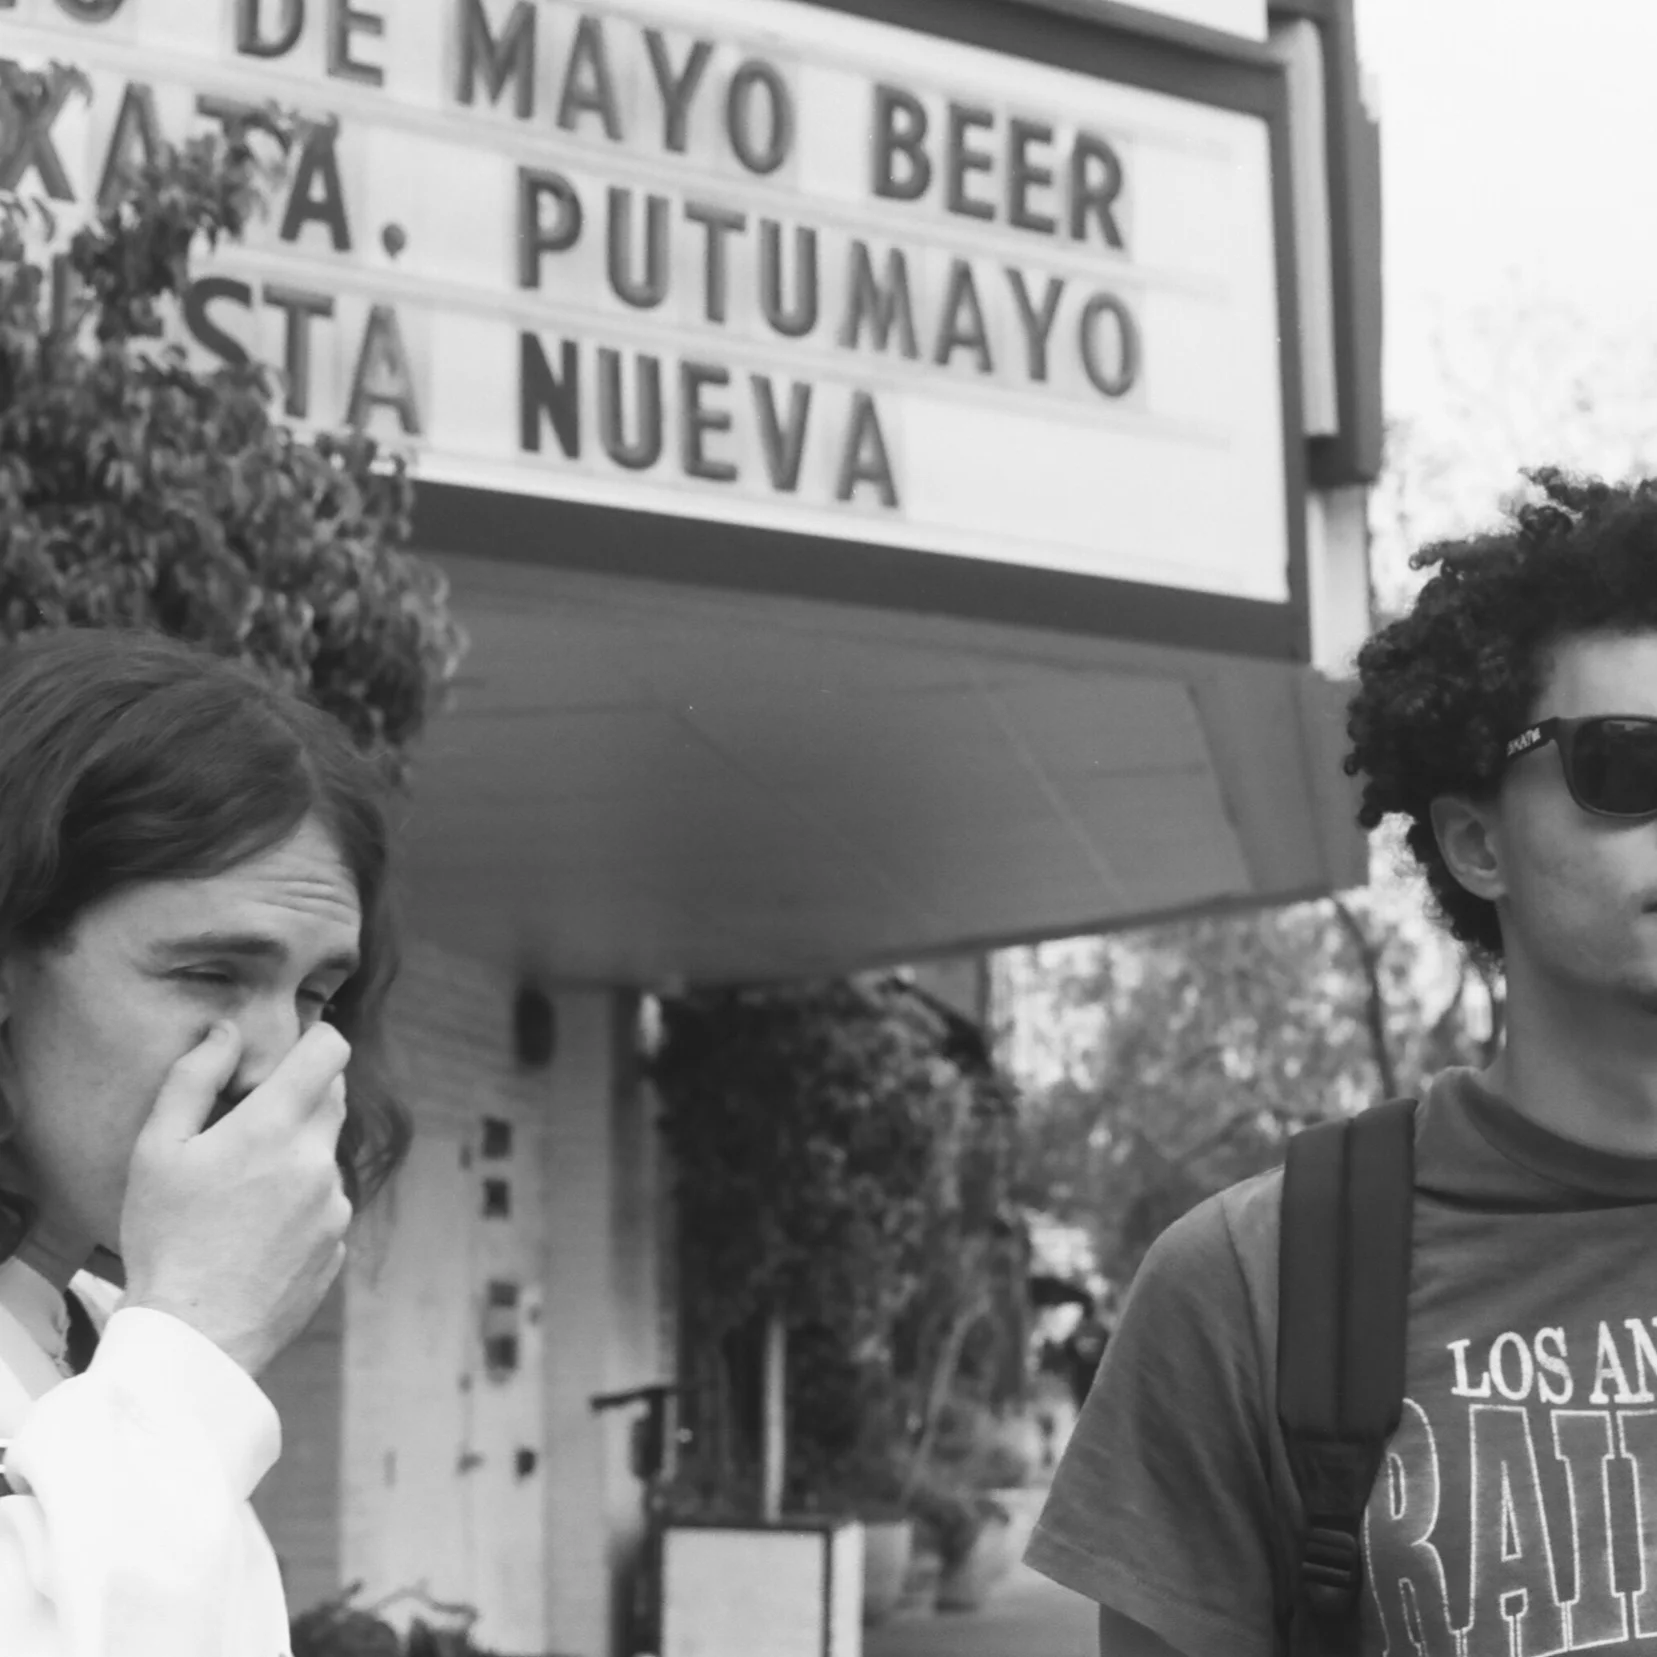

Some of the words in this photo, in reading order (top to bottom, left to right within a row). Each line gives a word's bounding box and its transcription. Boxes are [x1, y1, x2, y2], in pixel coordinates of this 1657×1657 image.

[457, 0, 796, 176] MAYO
[872, 81, 1126, 252] BEER
[517, 166, 1142, 399] PUTUMAYO
[519, 330, 900, 508] NUEVA
[1447, 1326, 1574, 1405] LOS
